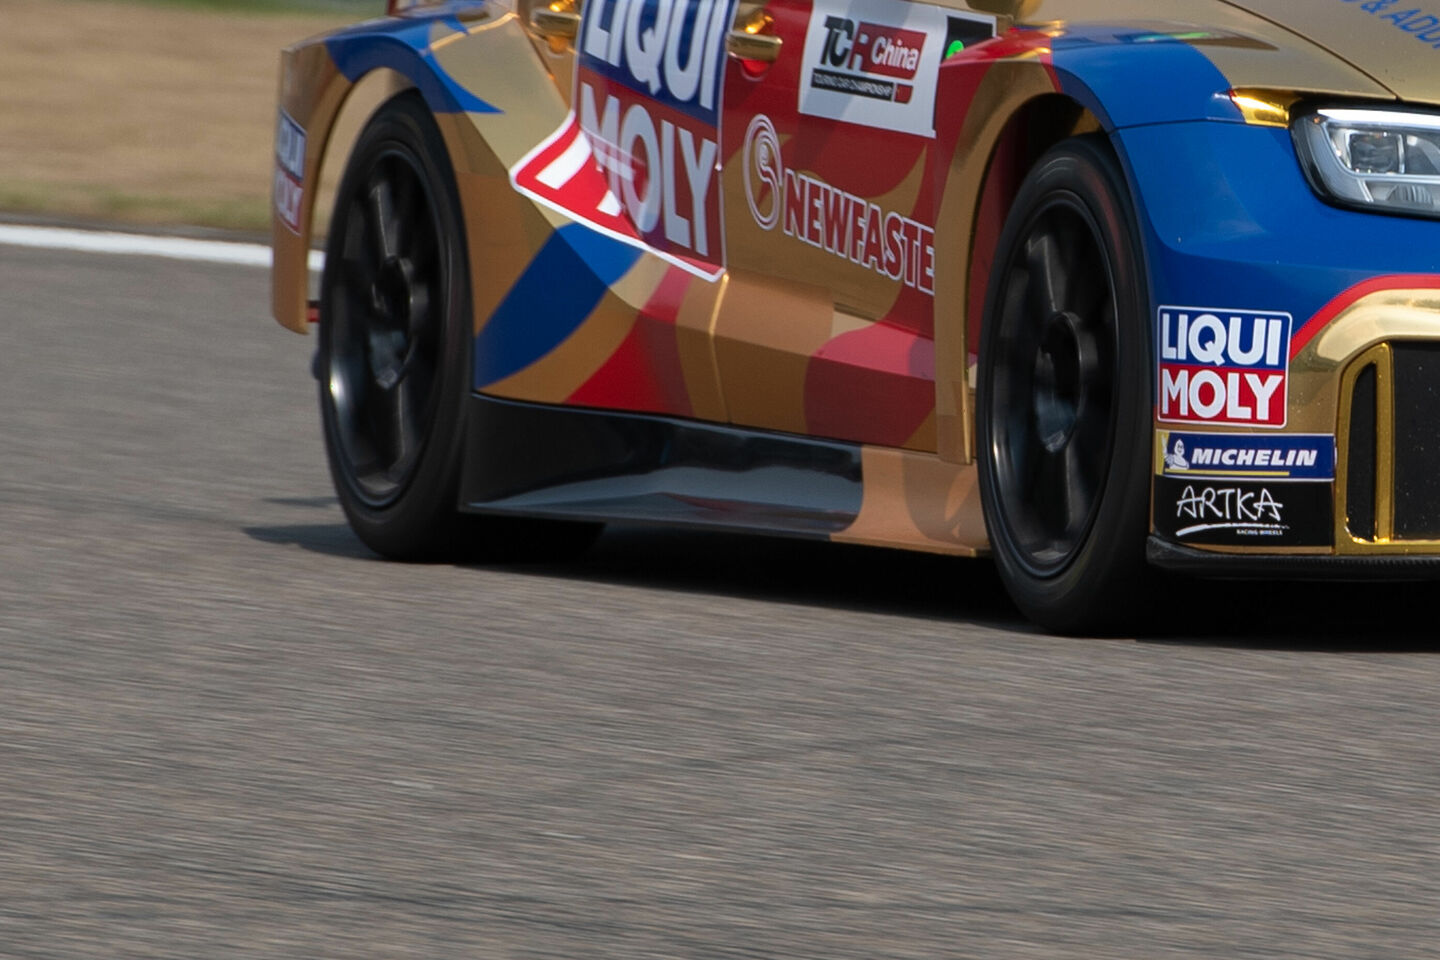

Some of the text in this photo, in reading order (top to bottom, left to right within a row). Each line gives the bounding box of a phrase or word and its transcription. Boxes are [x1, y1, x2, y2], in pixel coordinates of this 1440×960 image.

[870, 35, 919, 71] China
[536, 82, 718, 257] MOLY
[783, 169, 935, 295] NEWFASTE
[1162, 313, 1282, 366] LIQUI
[1162, 368, 1284, 421] MOLY
[1191, 448, 1318, 467] MICHELIN
[1176, 485, 1284, 522] ARTKA
